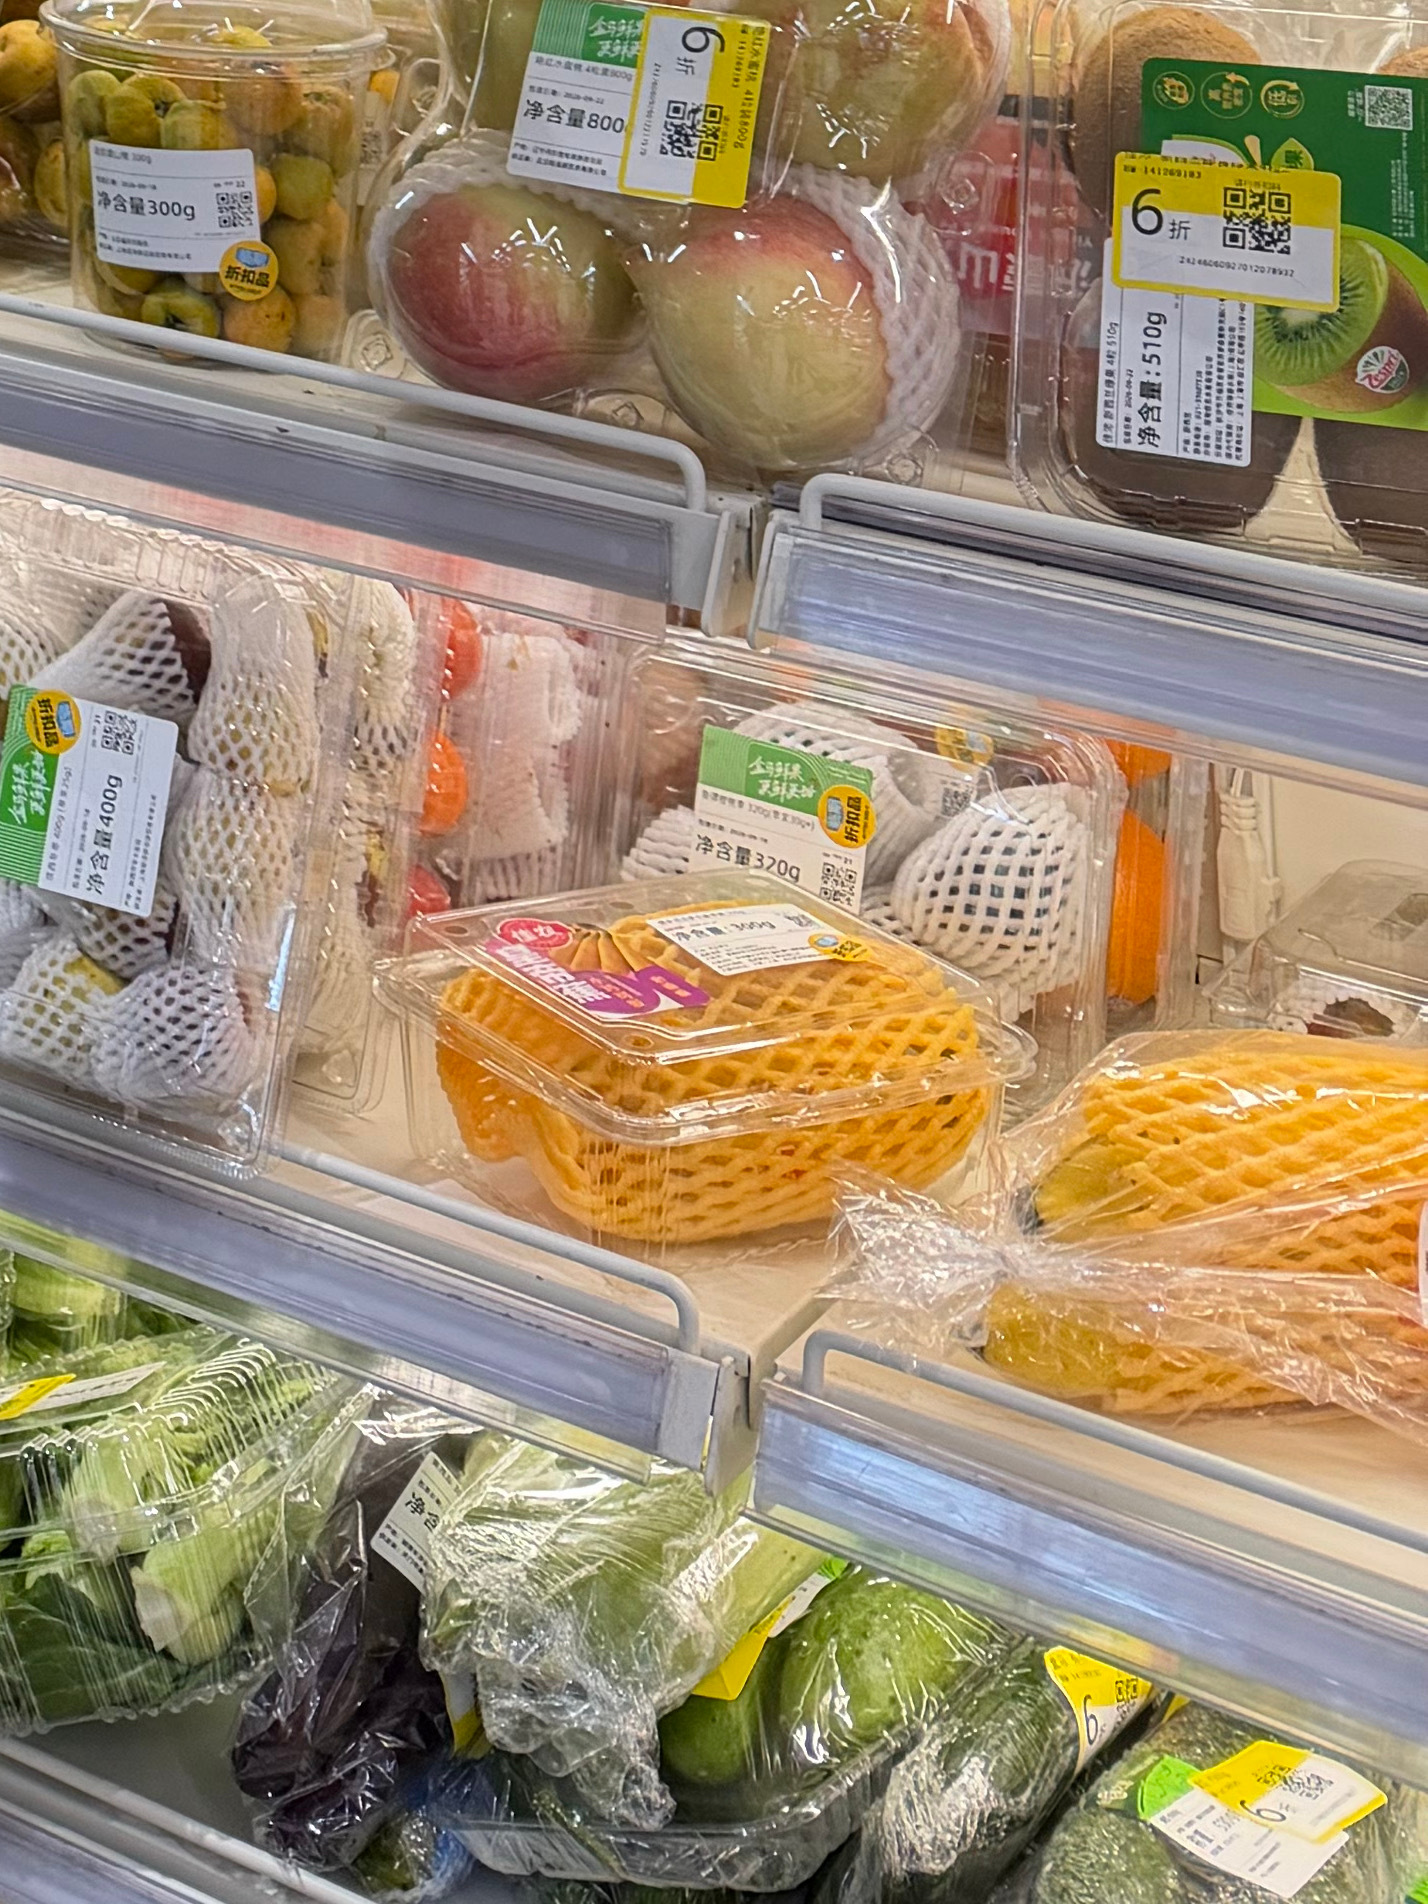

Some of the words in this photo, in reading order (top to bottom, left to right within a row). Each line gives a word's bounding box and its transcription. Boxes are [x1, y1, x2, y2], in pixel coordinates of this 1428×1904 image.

[97, 189, 196, 221] 净含量300g
[1130, 188, 1193, 242] 6折
[1137, 310, 1168, 448] 净含量:510g
[86, 774, 124, 895] 净含量400g
[695, 832, 802, 884] 净含量320g
